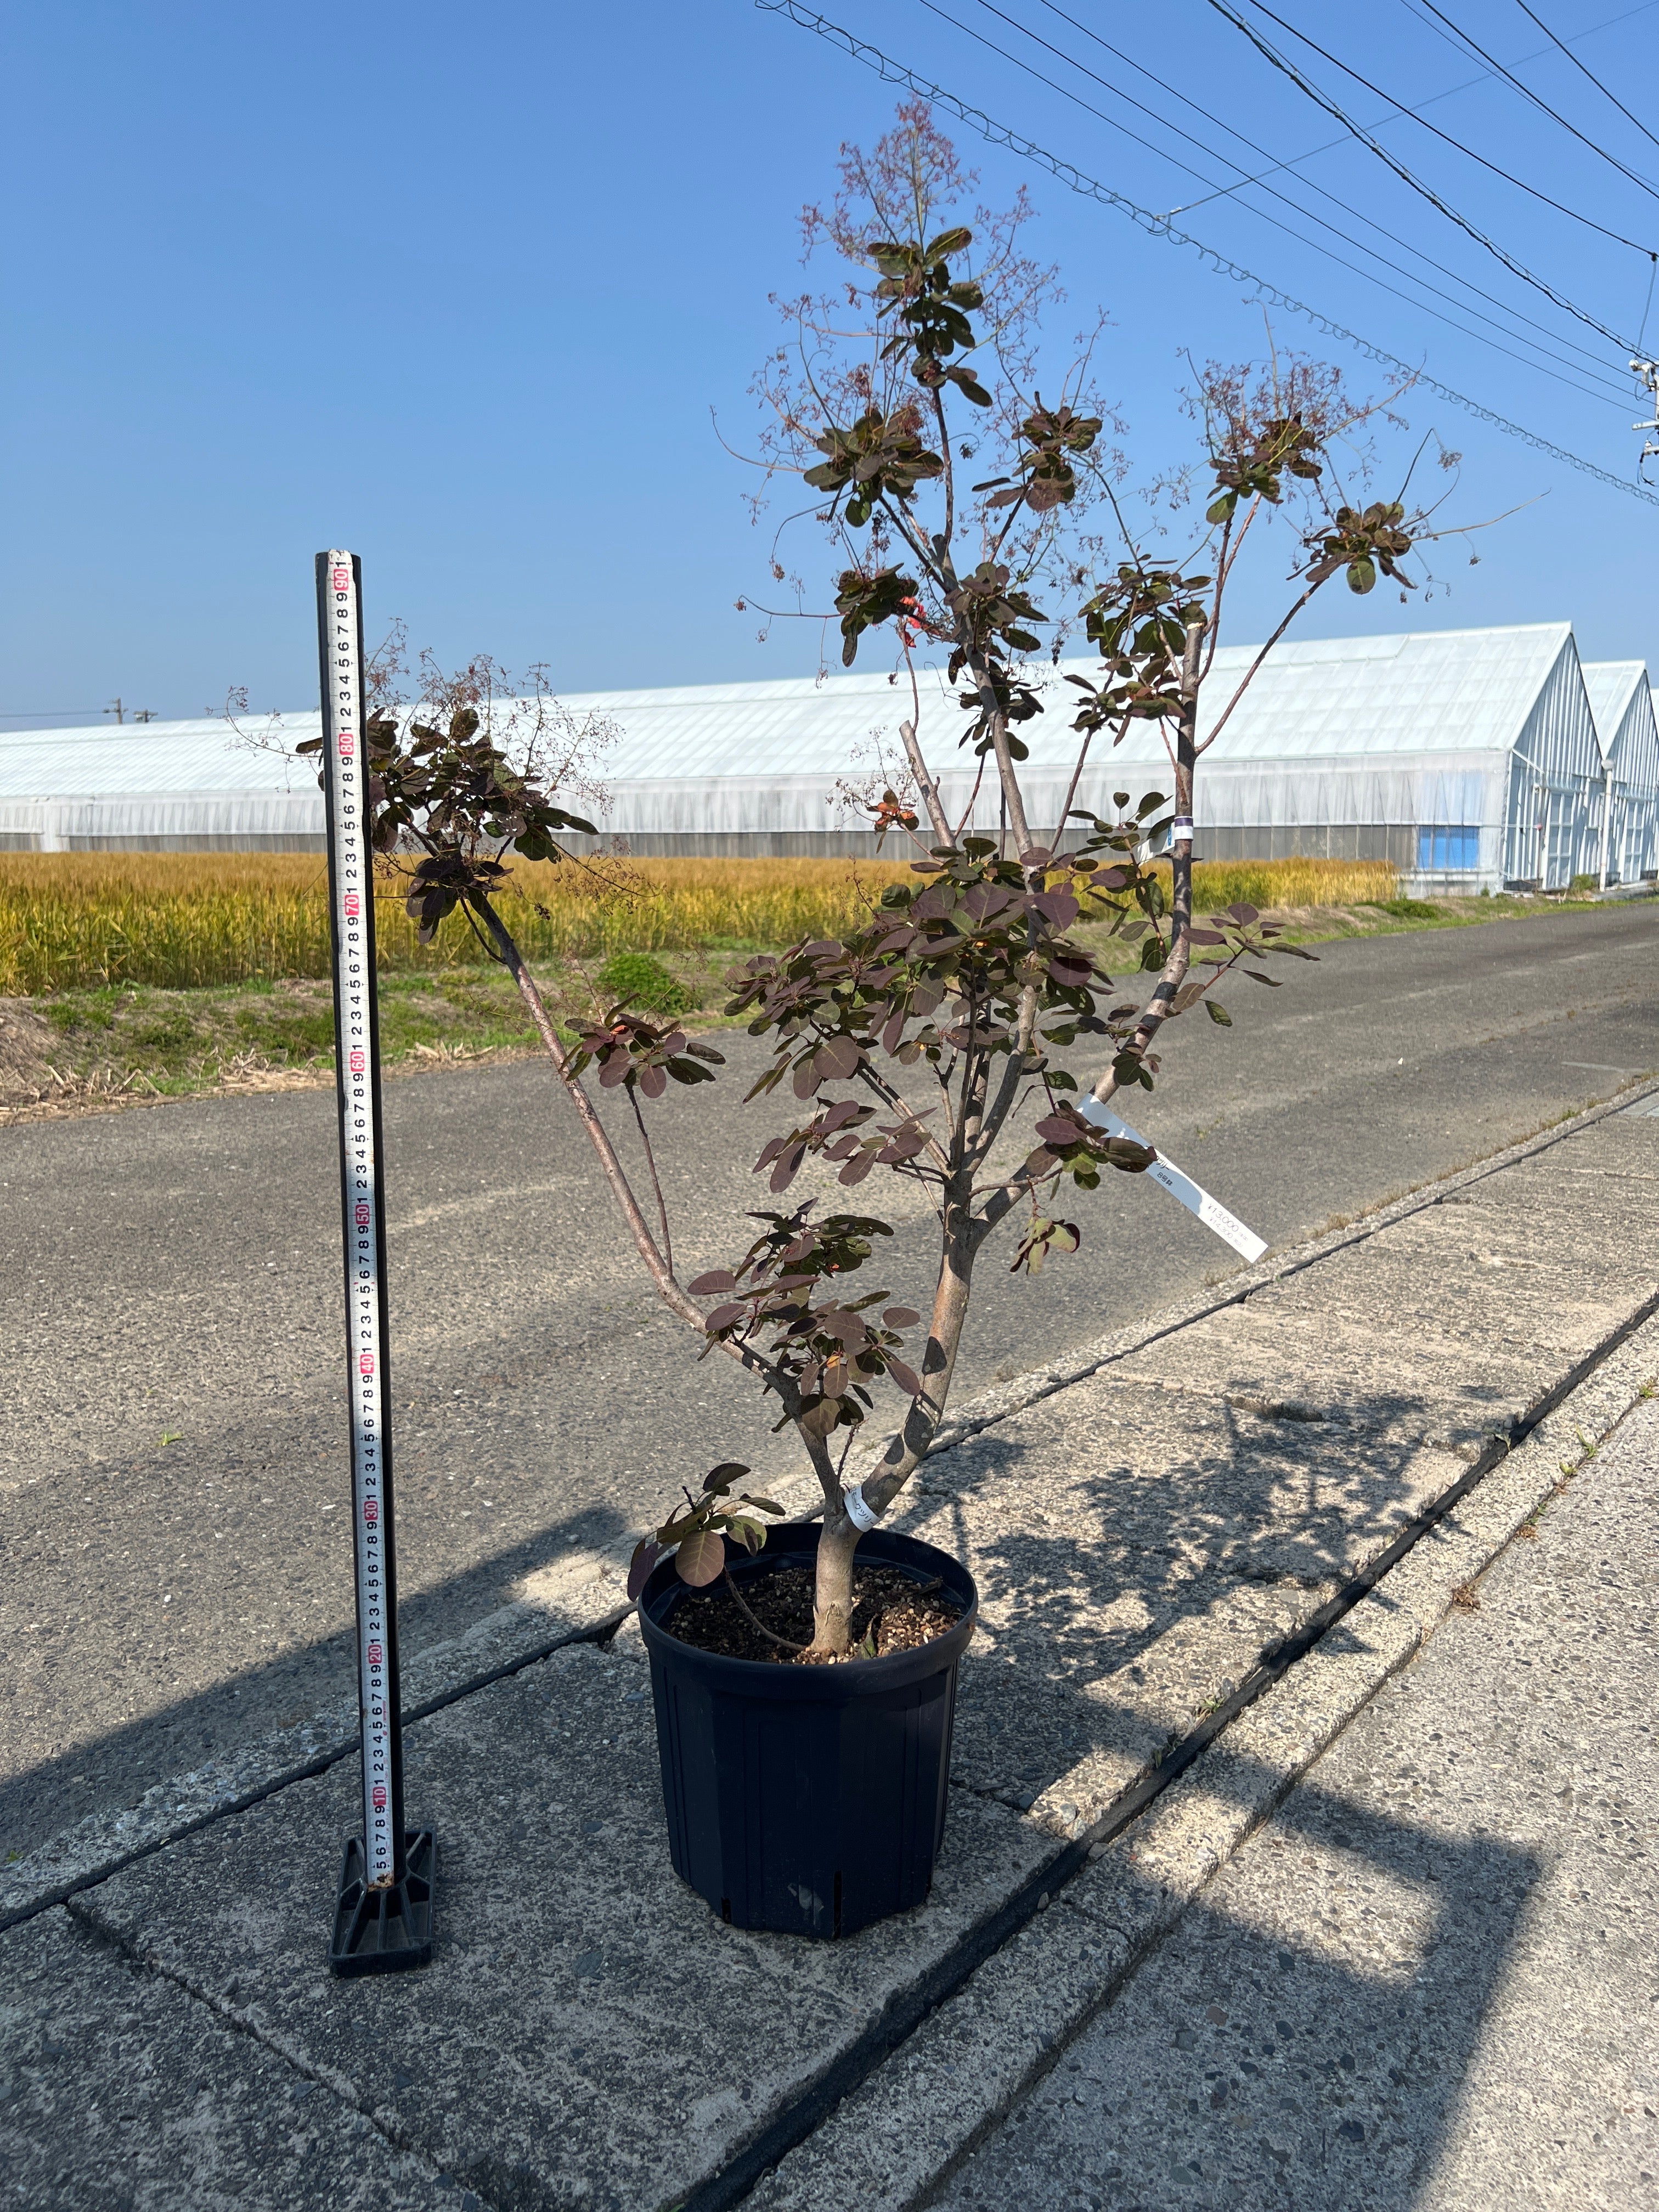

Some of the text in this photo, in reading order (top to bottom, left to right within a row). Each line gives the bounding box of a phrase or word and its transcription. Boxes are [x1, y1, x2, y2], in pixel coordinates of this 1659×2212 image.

[334, 571, 348, 588] 90
[336, 592, 348, 602] 9
[336, 608, 348, 618] 8
[337, 625, 348, 635] 7
[337, 642, 349, 651] 6
[338, 658, 350, 668] 5
[338, 675, 350, 685] 4
[339, 691, 351, 701] 3
[340, 707, 351, 716] 2
[340, 736, 353, 753] 80
[341, 757, 353, 766] 9
[342, 772, 354, 782] 8
[342, 788, 354, 798] 7
[343, 805, 355, 814] 6
[344, 821, 356, 830] 5
[345, 837, 356, 847] 4
[345, 853, 357, 862] 3
[346, 869, 357, 878] 2
[345, 896, 359, 913] 70
[347, 917, 359, 926] 9
[348, 932, 359, 942] 8
[348, 948, 359, 957] 7
[349, 964, 360, 973] 6
[349, 980, 360, 989] 5
[350, 995, 361, 1005] 4
[351, 1011, 362, 1020] 3
[351, 1026, 362, 1035] 2
[351, 1053, 364, 1069] 60
[353, 1073, 364, 1082] 9
[353, 1088, 364, 1097] 8
[354, 1103, 365, 1113] 7
[354, 1119, 365, 1128] 6
[355, 1134, 366, 1143] 5
[355, 1149, 366, 1159] 4
[356, 1164, 367, 1173] 3
[356, 1180, 368, 1189] 2
[356, 1206, 369, 1222] 50
[357, 1225, 369, 1234] 9
[358, 1240, 369, 1249] 8
[358, 1255, 370, 1265] 7
[359, 1270, 370, 1279] 6
[359, 1285, 370, 1294] 5
[360, 1300, 370, 1309] 4
[360, 1315, 371, 1324] 3
[360, 1330, 371, 1339] 2
[361, 1356, 374, 1372] 40
[362, 1375, 373, 1384] 9
[363, 1389, 374, 1398] 8
[363, 1404, 374, 1413] 7
[363, 1419, 374, 1427] 6
[363, 1434, 375, 1442] 5
[364, 1448, 375, 1457] 4
[365, 1463, 376, 1472] 3
[365, 1477, 376, 1486] 2
[365, 1503, 377, 1517] 30
[366, 1521, 377, 1530] 9
[366, 1535, 378, 1544] 8
[367, 1550, 378, 1559] 7
[368, 1564, 379, 1573] 6
[368, 1579, 379, 1587] 5
[368, 1593, 379, 1602] 4
[369, 1607, 380, 1616] 3
[369, 1622, 380, 1630] 2
[369, 1646, 381, 1661] 20
[370, 1664, 381, 1673] 9
[371, 1678, 382, 1688] 8
[371, 1693, 382, 1702] 7
[371, 1707, 382, 1716] 6
[372, 1721, 383, 1729] 5
[373, 1735, 383, 1743] 4
[373, 1749, 384, 1758] 3
[373, 1763, 384, 1771] 2
[374, 1788, 385, 1802] 10
[374, 1805, 385, 1814] 9
[375, 1819, 386, 1827] 8
[375, 1833, 386, 1842] 7
[375, 1847, 387, 1855] 6
[376, 1861, 387, 1869] 5
